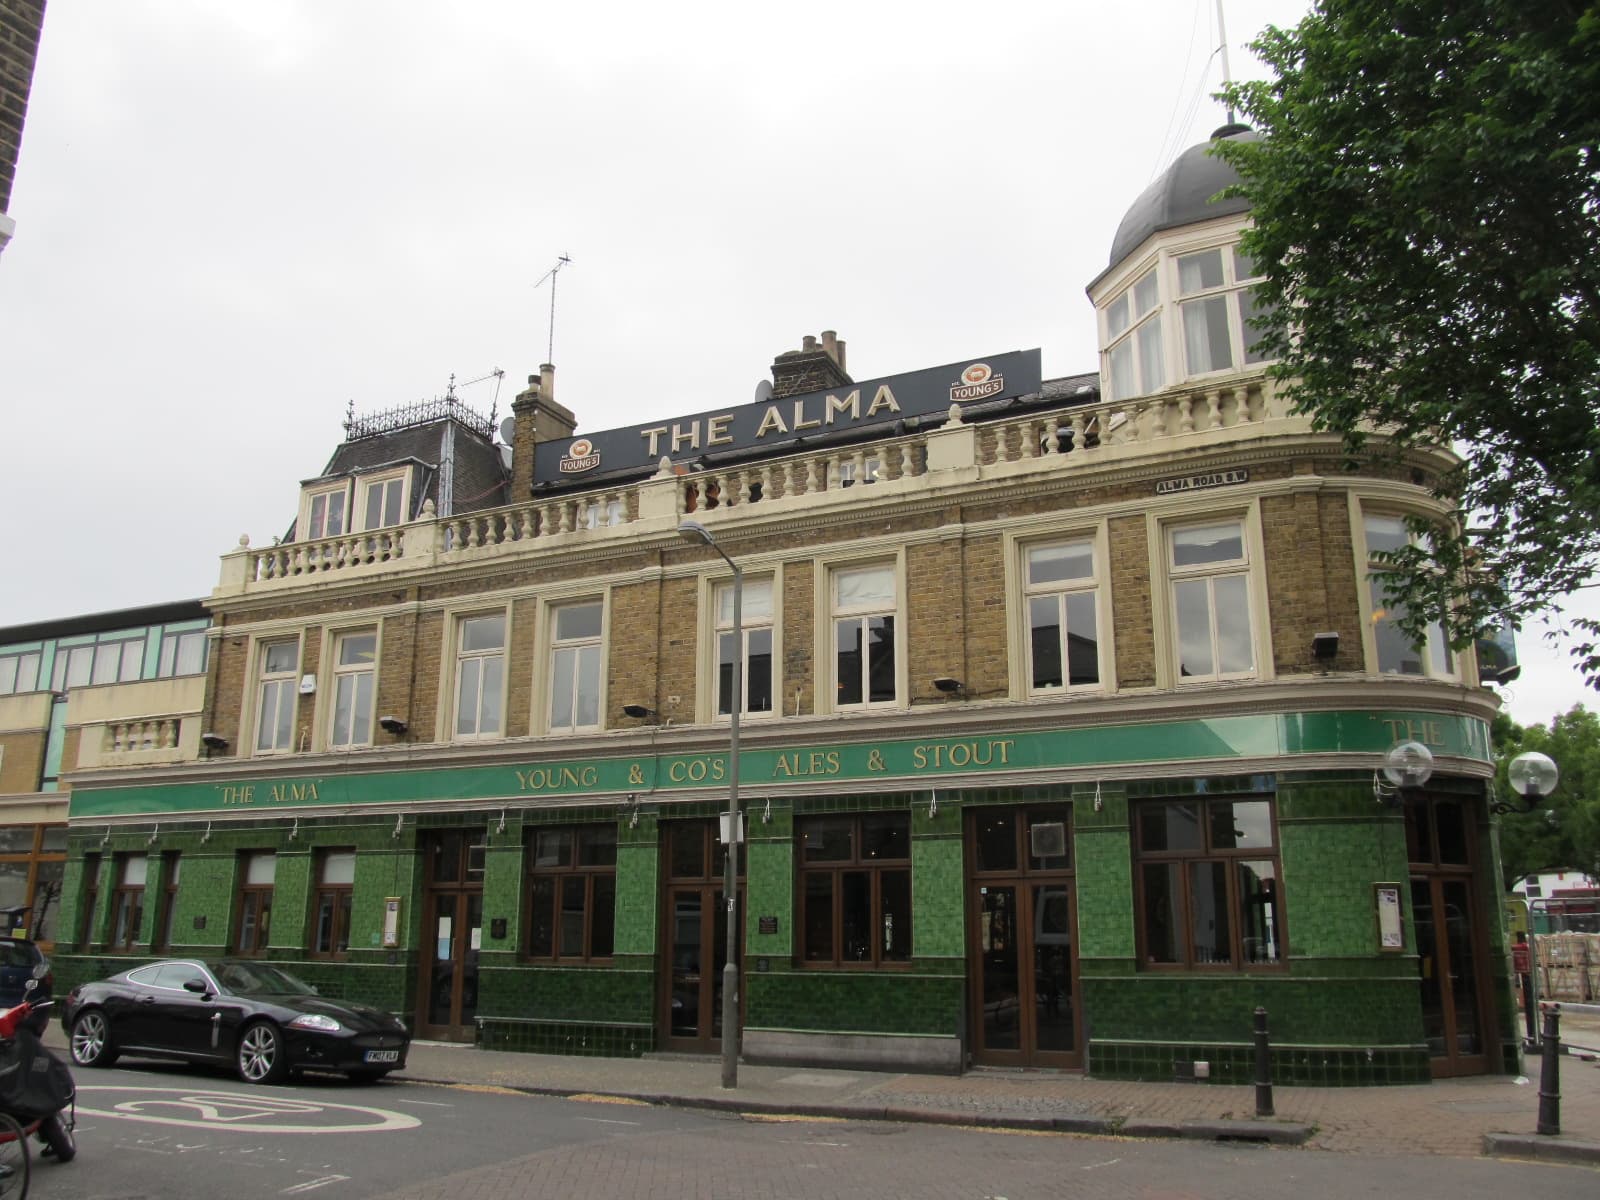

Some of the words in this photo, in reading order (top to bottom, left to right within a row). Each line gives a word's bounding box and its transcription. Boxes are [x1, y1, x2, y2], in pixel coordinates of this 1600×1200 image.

[954, 382, 999, 398] YOUNG'S
[641, 414, 734, 456] THE
[756, 385, 900, 438] ALMA
[1158, 478, 1189, 492] ALMA
[515, 767, 598, 790] YOUNG
[628, 764, 643, 784] &
[669, 757, 725, 782] CO'S
[772, 751, 841, 776] ALES
[867, 749, 886, 771] &
[913, 739, 1014, 769] STOUT
[114, 1096, 324, 1121] 20
